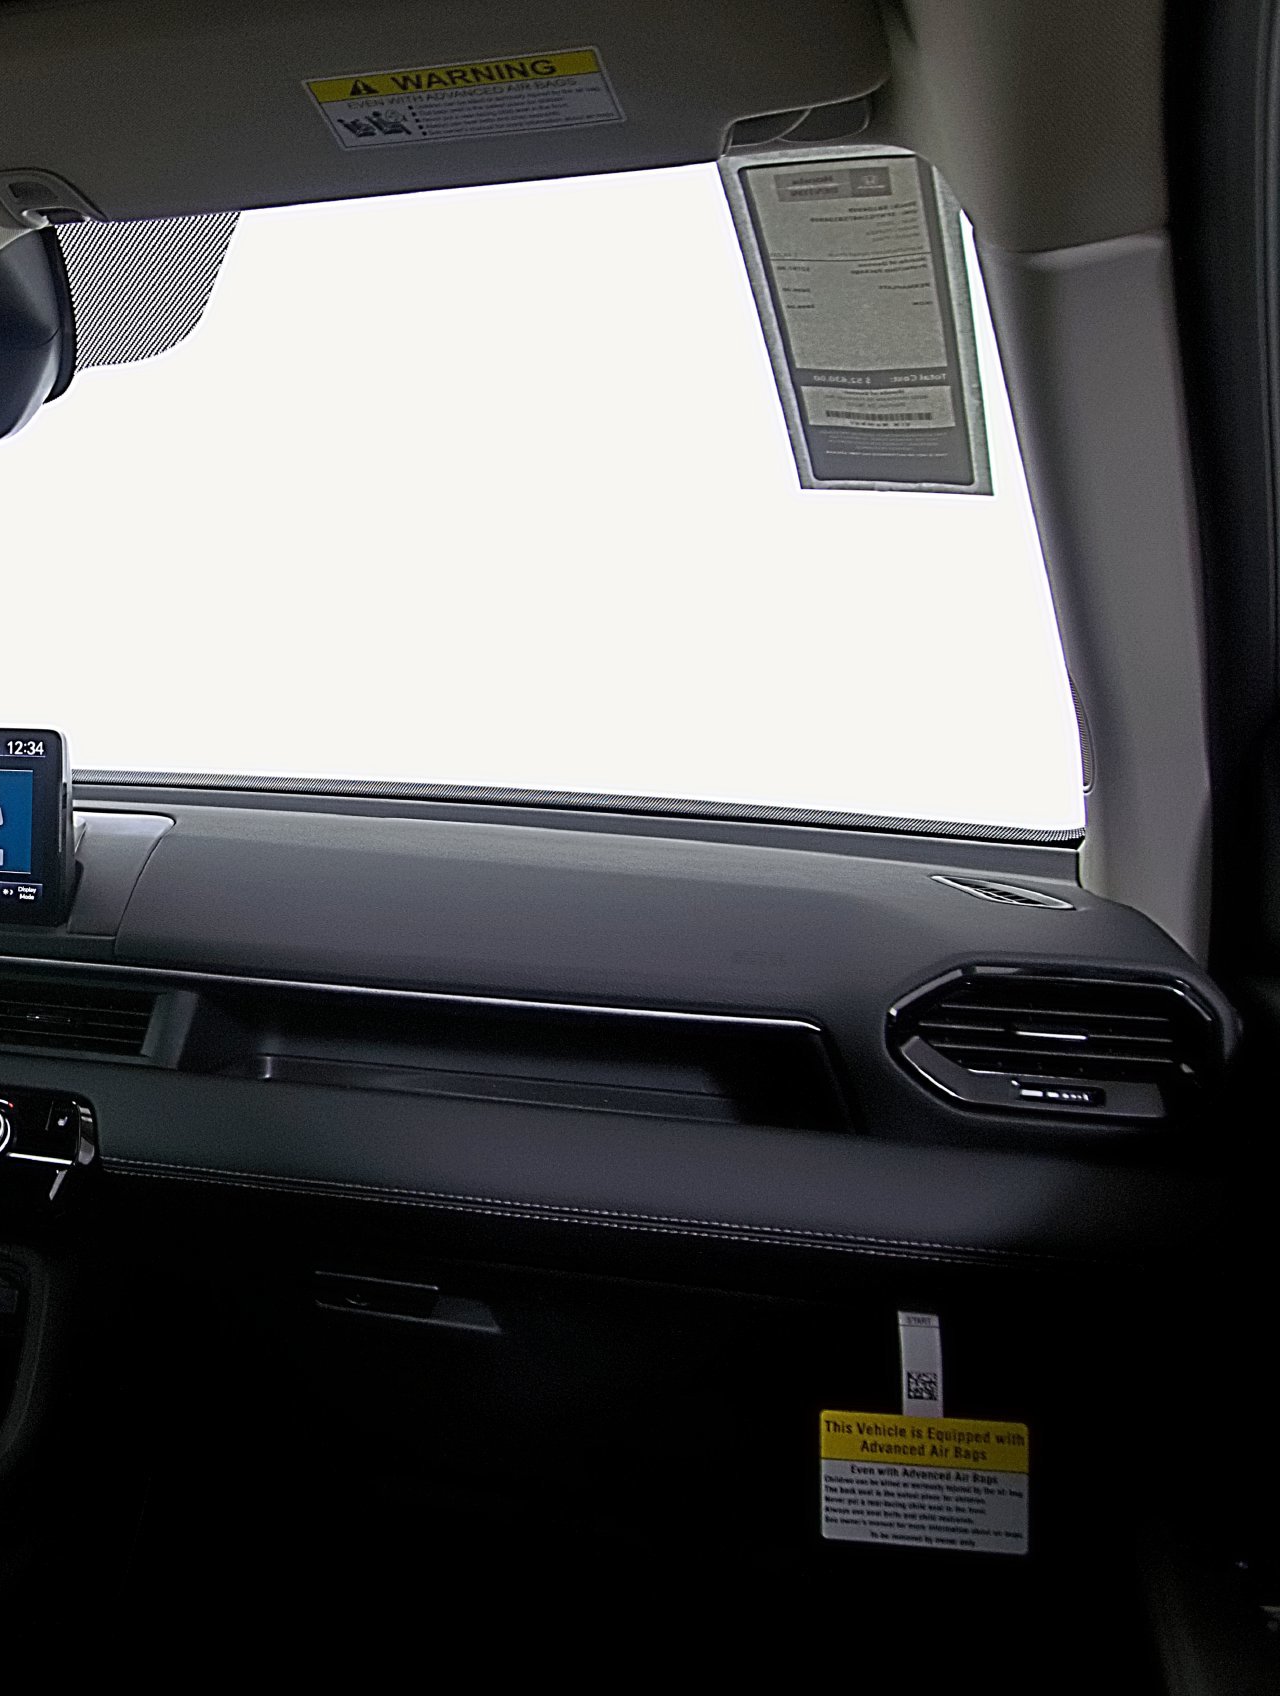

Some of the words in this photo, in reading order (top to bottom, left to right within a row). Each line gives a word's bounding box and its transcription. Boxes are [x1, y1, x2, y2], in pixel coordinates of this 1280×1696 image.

[390, 59, 557, 91] WARNING
[7, 740, 45, 756] 12:34
[18, 886, 37, 894] Display
[20, 893, 35, 901] Mode
[824, 1420, 853, 1434] This
[856, 1422, 907, 1438] Vehicle
[910, 1425, 923, 1439] is
[927, 1426, 991, 1444] Equipped
[995, 1431, 1025, 1446] with
[861, 1440, 926, 1456] Advanced
[930, 1444, 949, 1458] Air
[954, 1446, 988, 1462] Bags
[850, 1464, 875, 1475] Even
[877, 1467, 899, 1477] with
[902, 1467, 952, 1480] Advanced
[955, 1471, 970, 1482] Air
[972, 1472, 999, 1485] Bags
